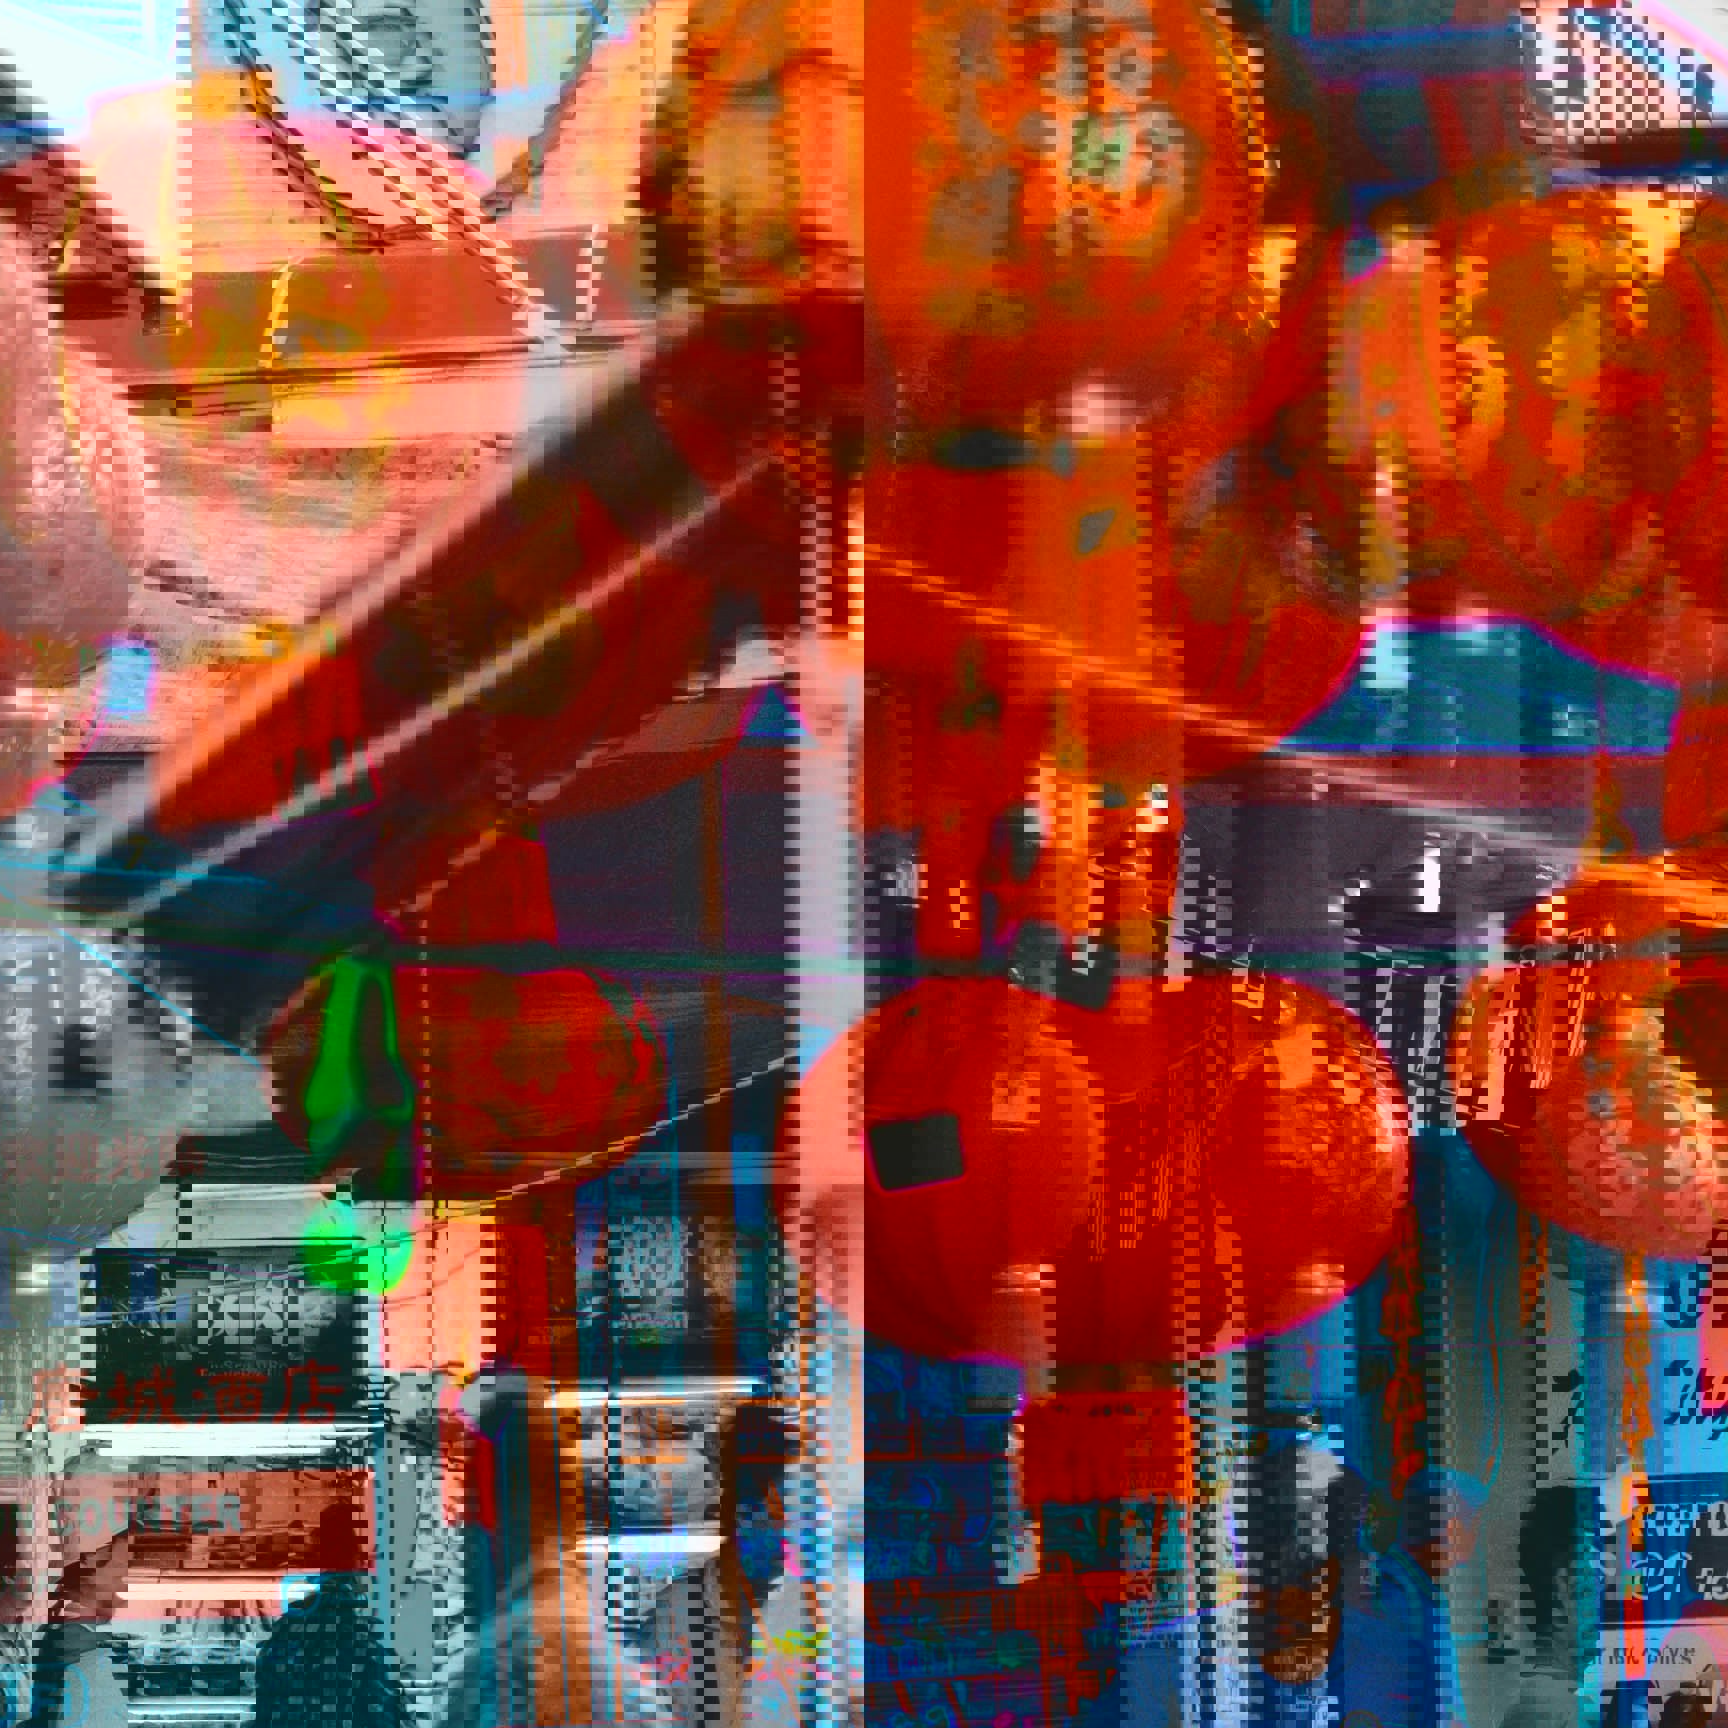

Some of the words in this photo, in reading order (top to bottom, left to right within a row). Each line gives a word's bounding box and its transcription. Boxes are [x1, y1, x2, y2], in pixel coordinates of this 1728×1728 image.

[1, 1128, 207, 1184] 欢迎光临
[23, 1359, 346, 1435] 唐城酒店
[49, 1494, 244, 1538] COUNTER
[339, 1582, 356, 1593] NO
[323, 1594, 373, 1606] PARKING
[98, 1646, 162, 1669] WI-FI
[170, 1643, 303, 1668] SERVICES
[140, 1675, 238, 1694] AIR-COND
[243, 1673, 304, 1692] ROOM
[104, 1702, 202, 1721] INTERNET
[207, 1700, 306, 1718] SERVICES
